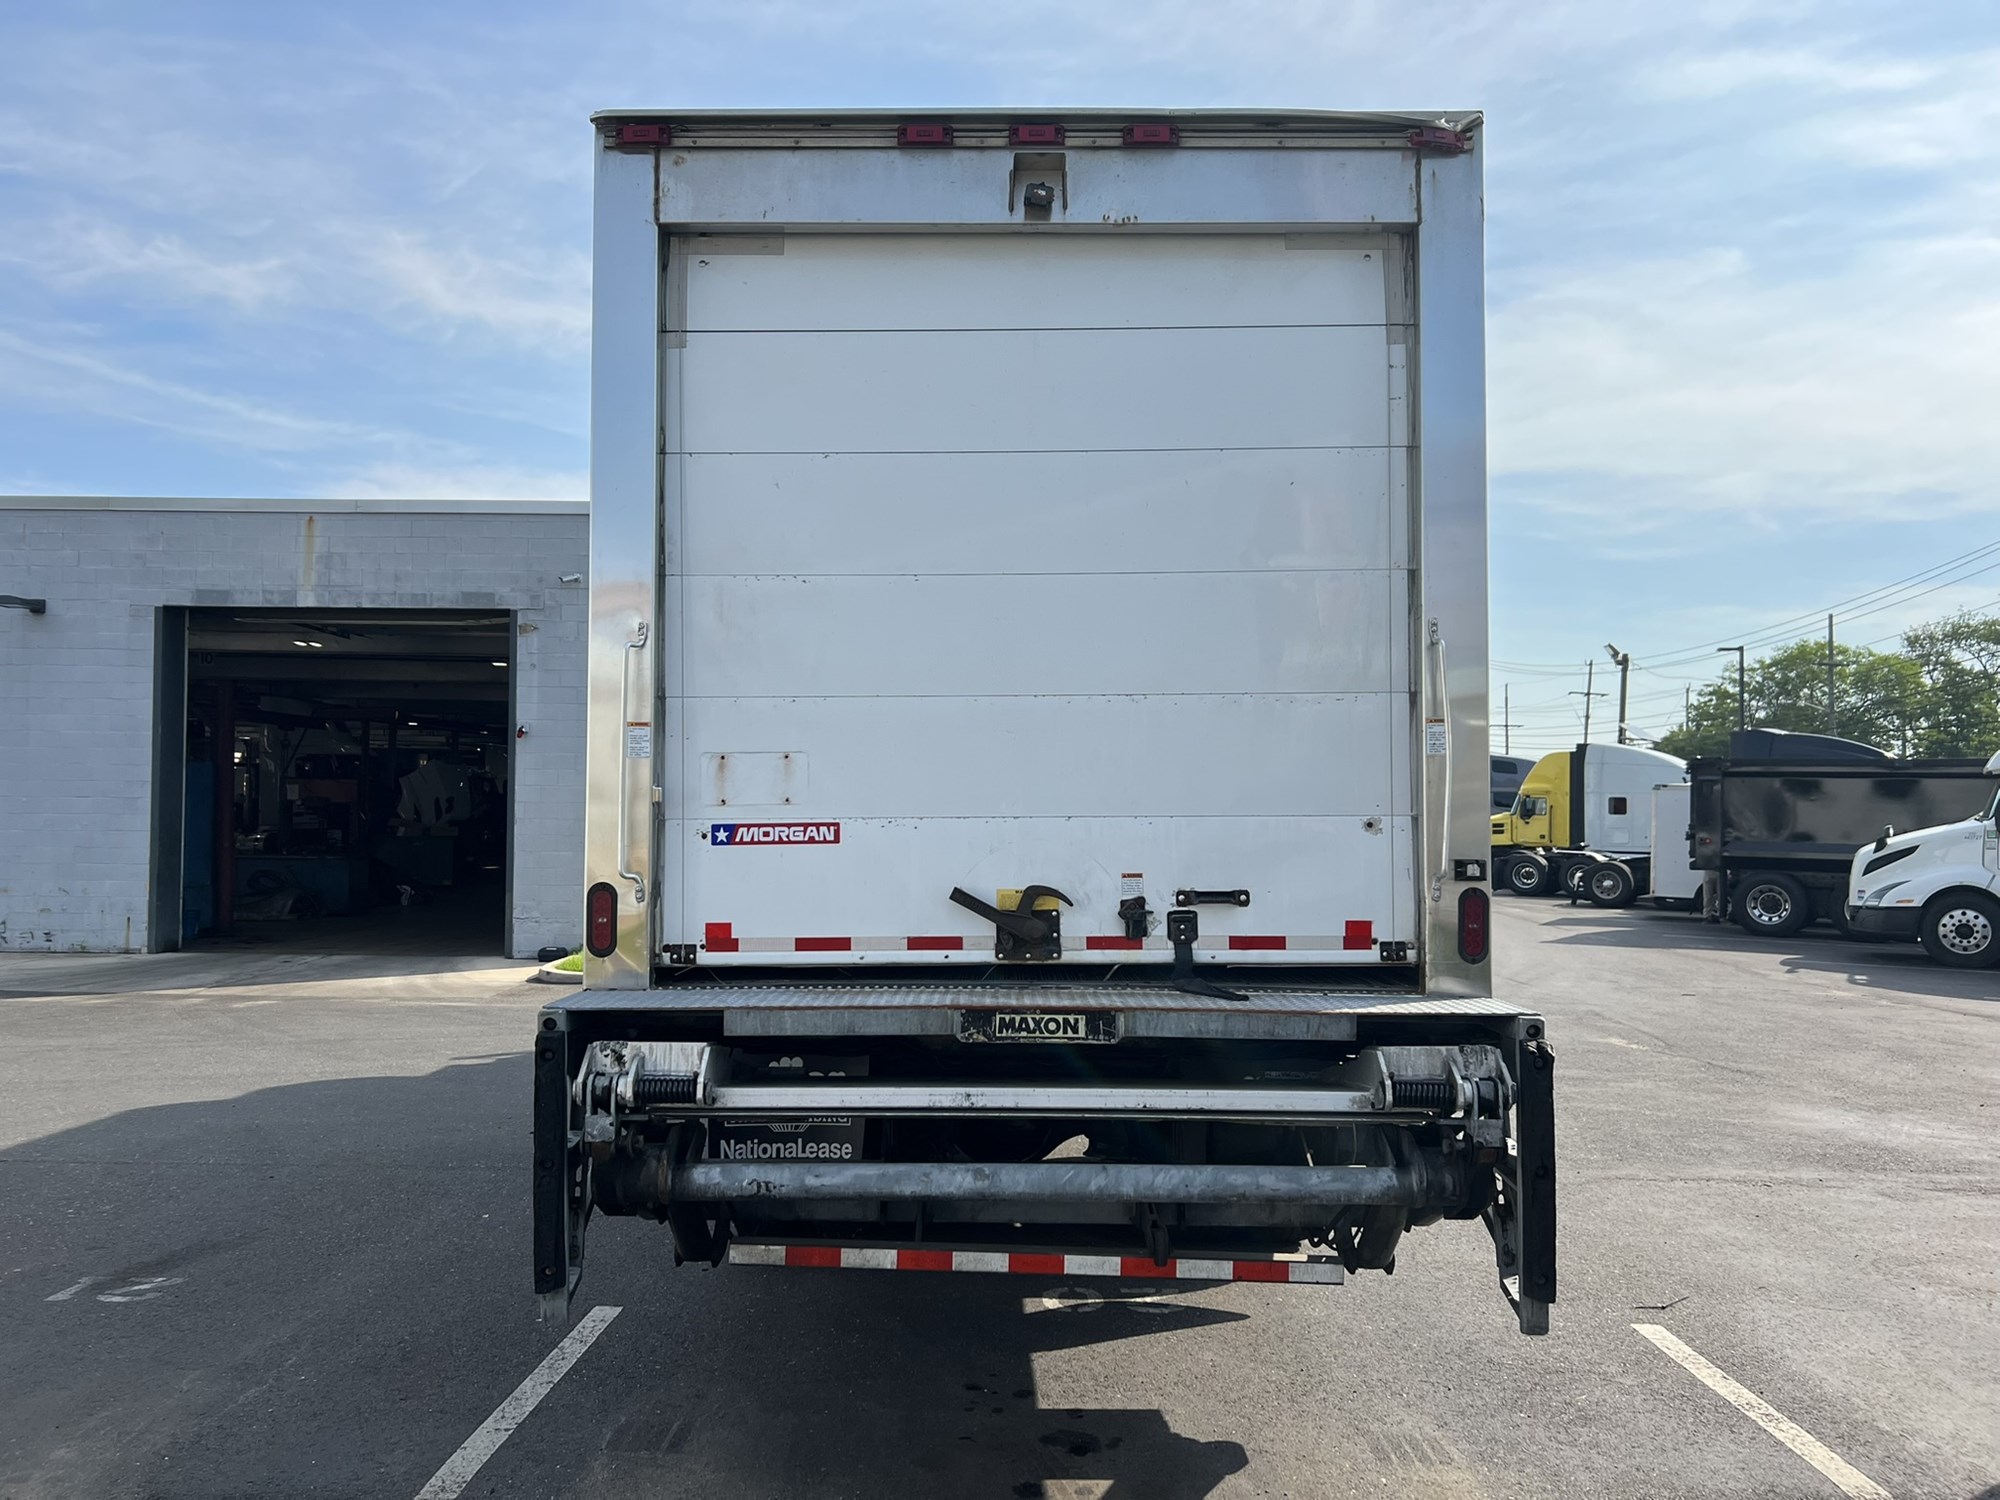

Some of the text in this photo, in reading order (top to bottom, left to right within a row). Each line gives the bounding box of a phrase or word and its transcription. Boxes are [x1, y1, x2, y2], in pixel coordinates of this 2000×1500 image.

[735, 825, 835, 842] MORGAN
[997, 1017, 1079, 1035] MAXON
[720, 1138, 852, 1160] NationaLease
